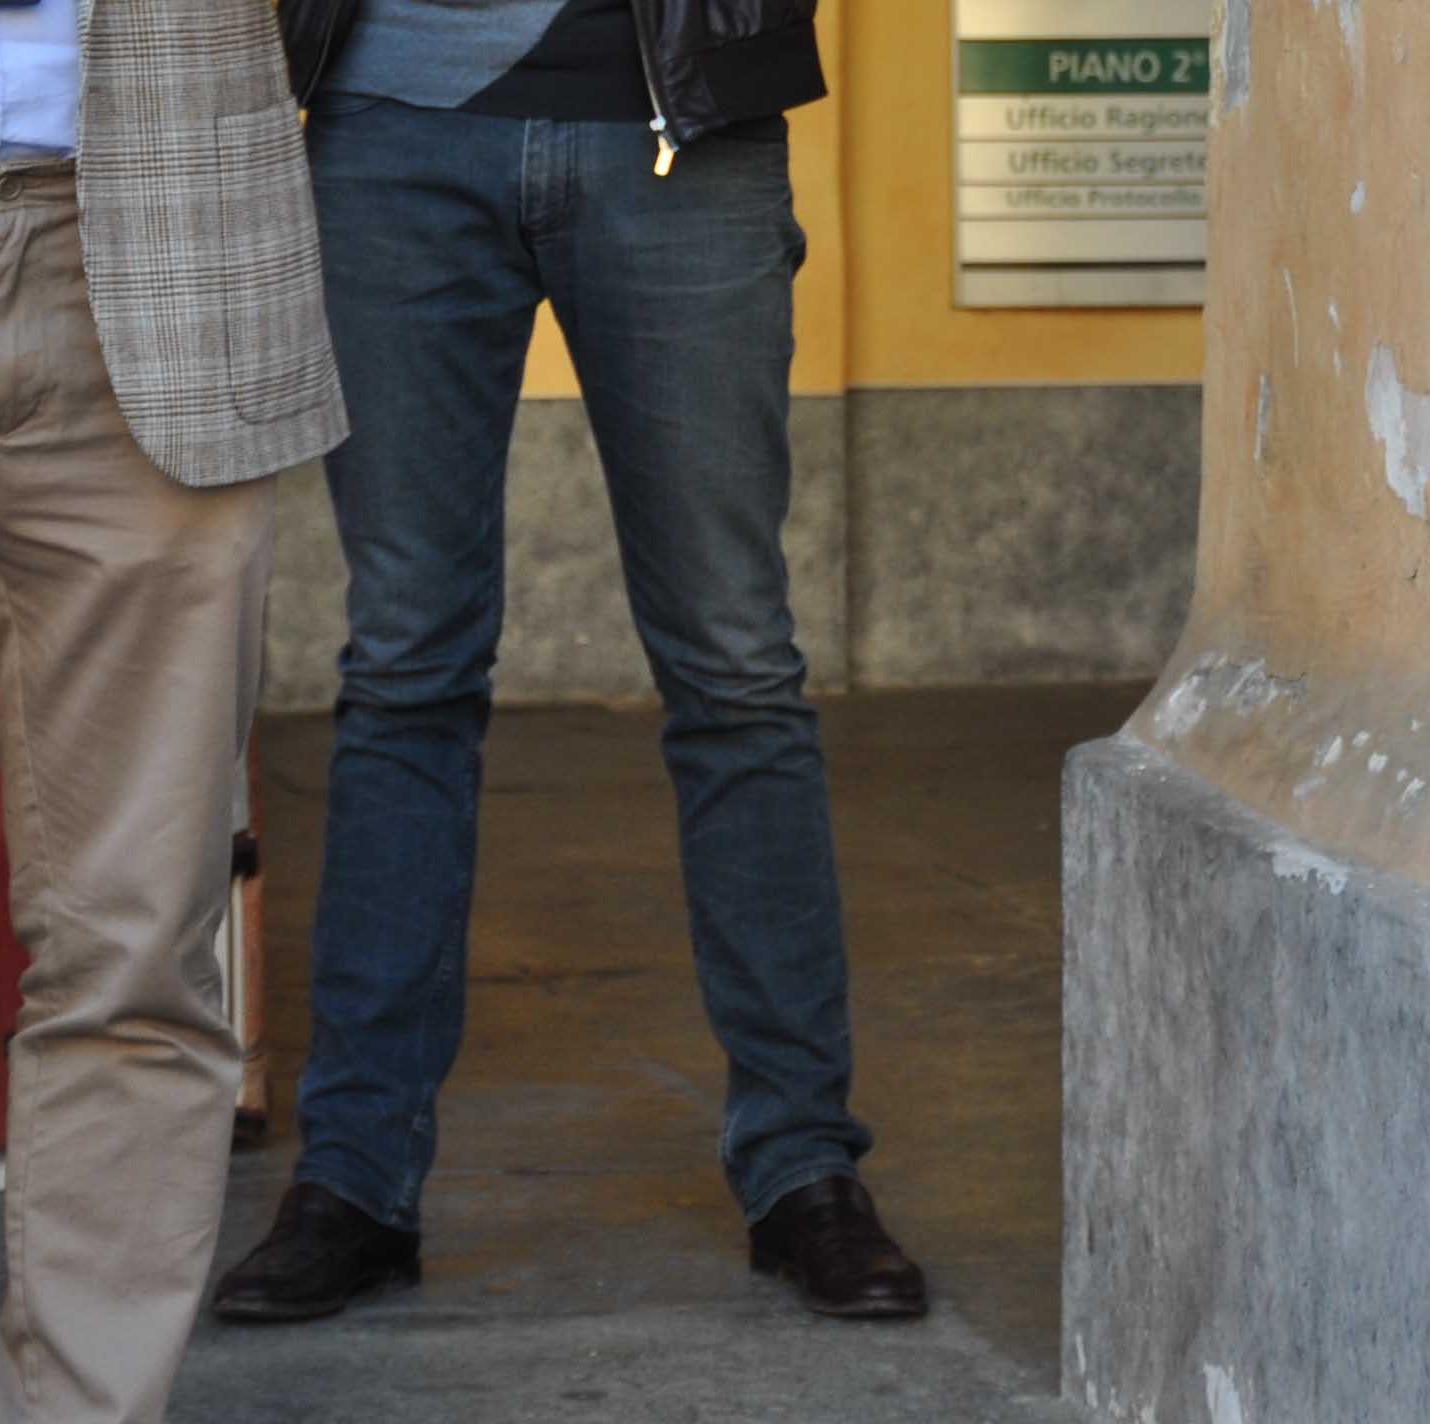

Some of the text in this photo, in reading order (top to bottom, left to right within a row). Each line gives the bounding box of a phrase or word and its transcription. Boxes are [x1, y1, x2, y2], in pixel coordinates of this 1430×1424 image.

[1048, 51, 1162, 84] PIANO
[1006, 107, 1097, 129] Ufficio
[1008, 151, 1099, 174] Ufficio
[1006, 189, 1201, 208] Ufficio Protocollo
